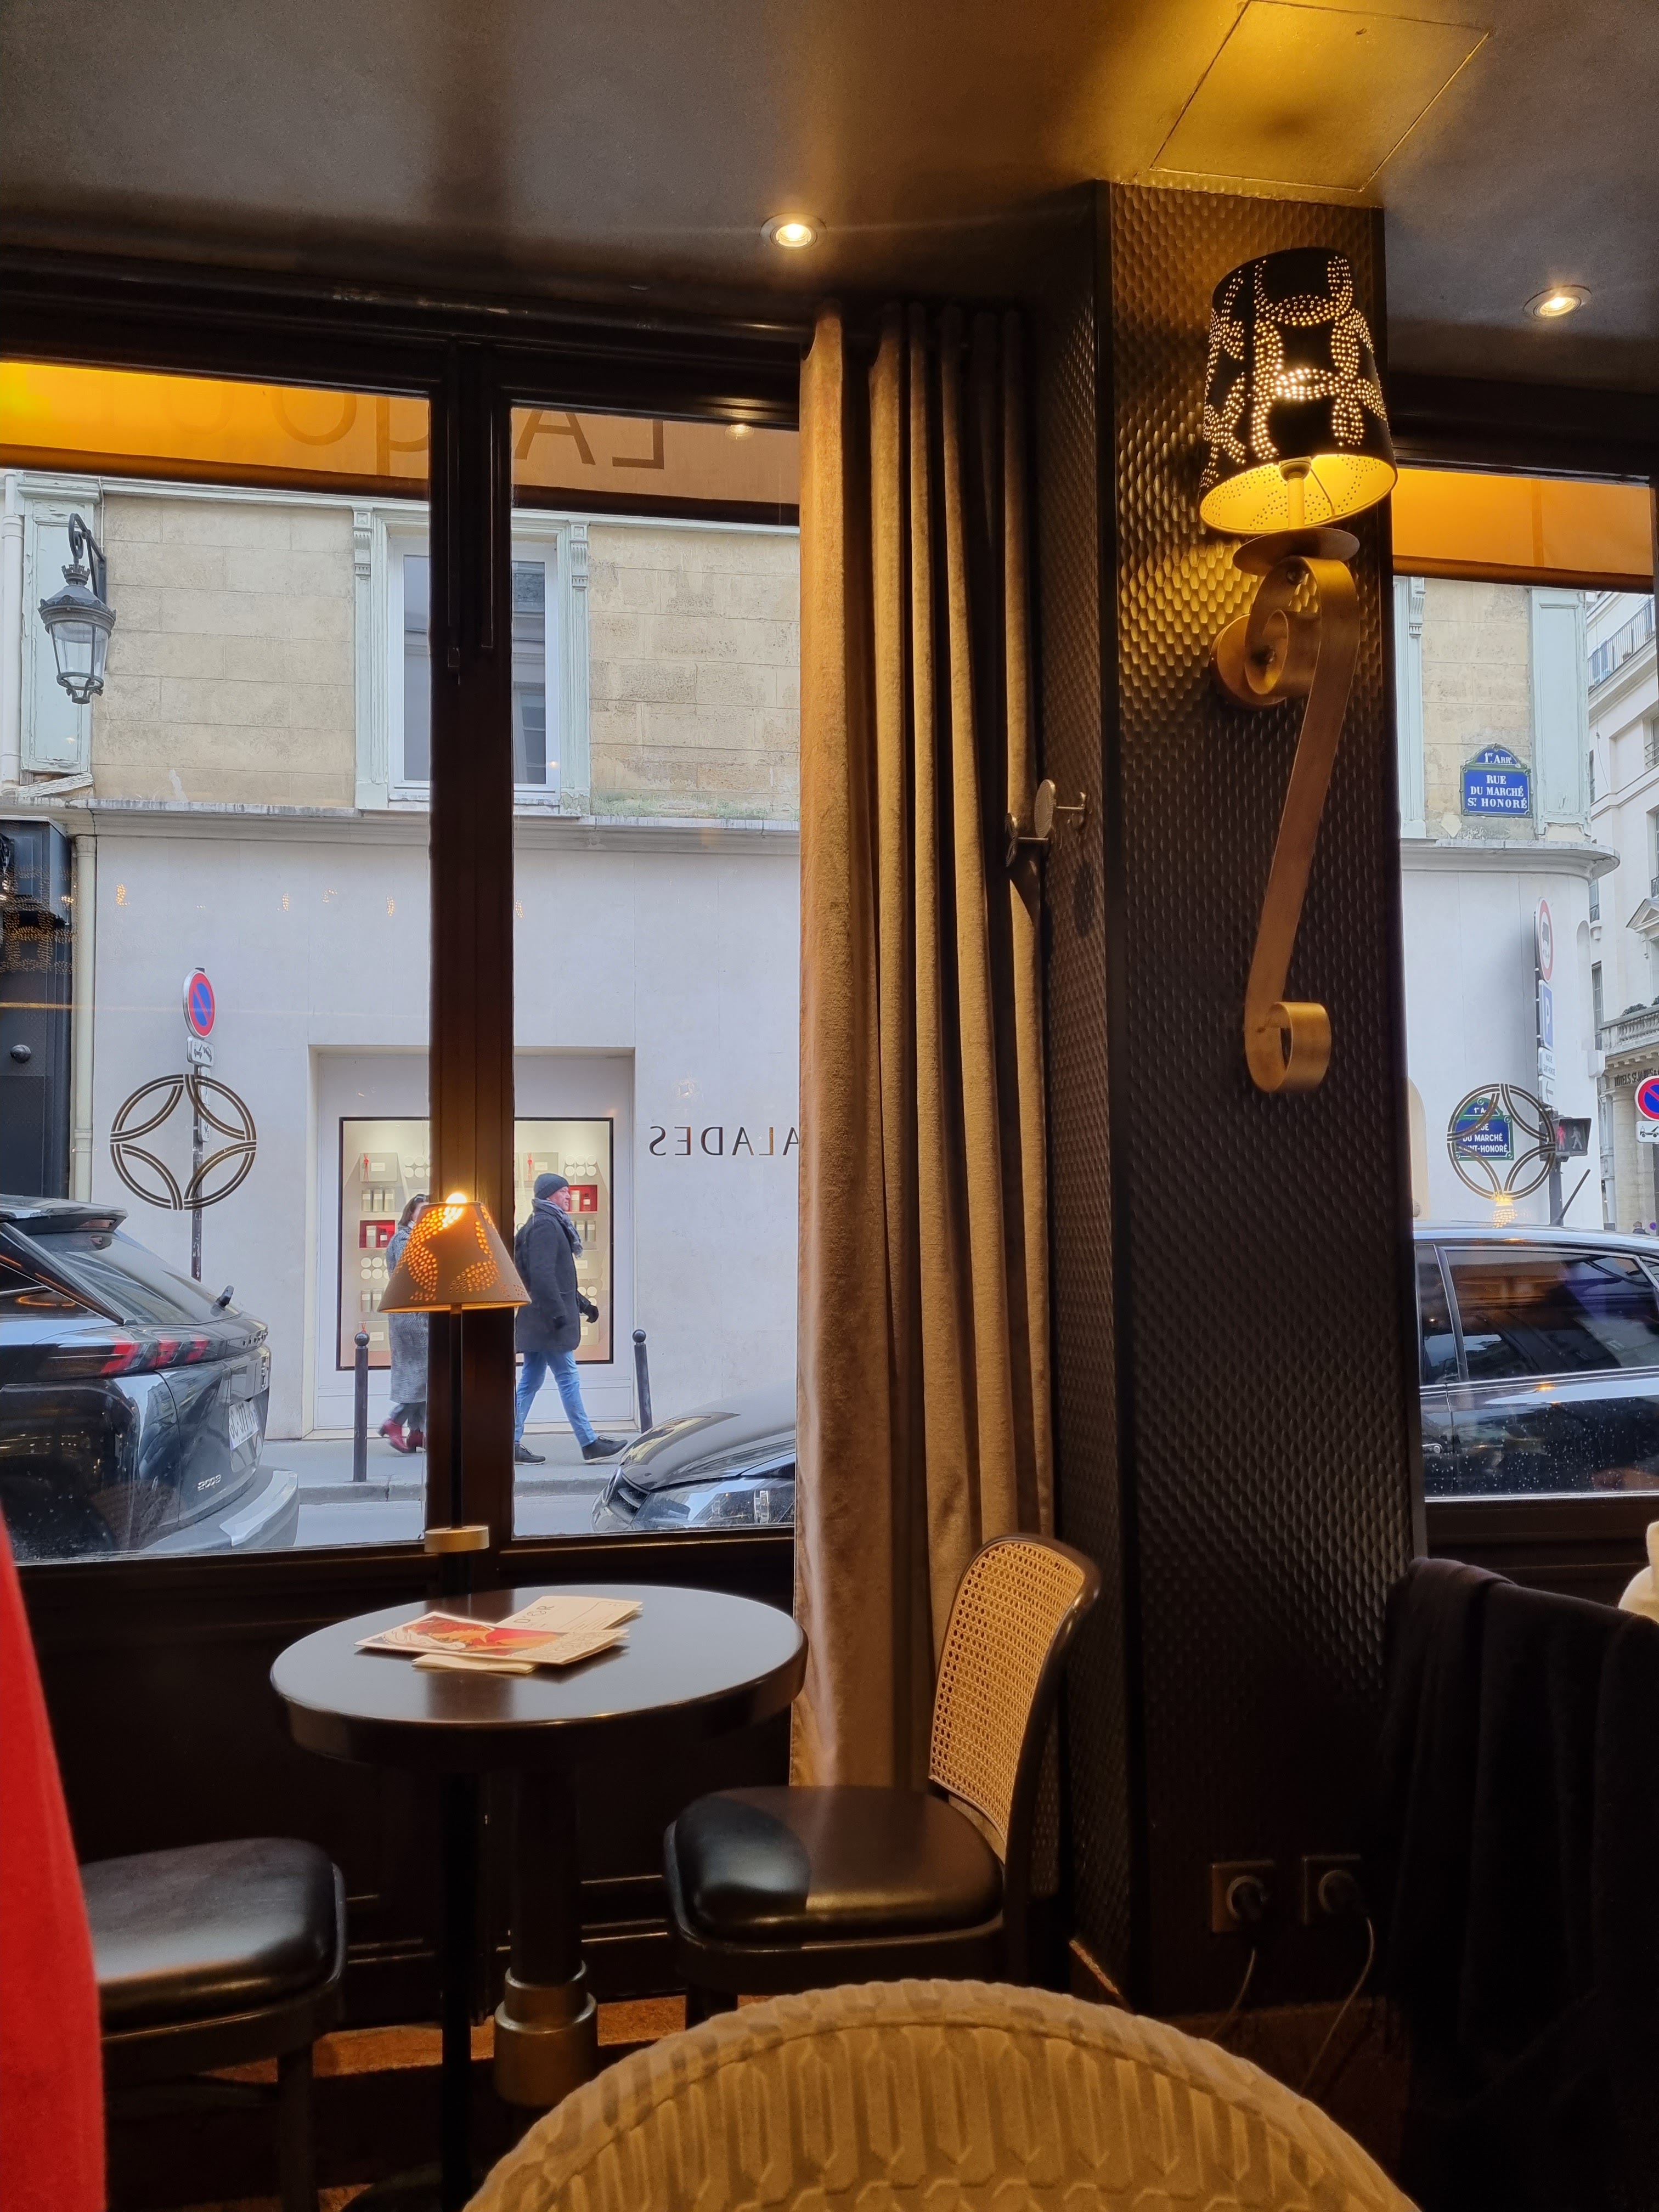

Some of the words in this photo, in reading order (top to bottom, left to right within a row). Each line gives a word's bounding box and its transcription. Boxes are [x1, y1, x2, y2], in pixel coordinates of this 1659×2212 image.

[1486, 775, 1506, 785] RUE
[1470, 786, 1483, 795] DU
[1487, 786, 1524, 797] MARCHÉ
[1481, 798, 1527, 809] HONORÉ
[1475, 1133, 1503, 1142] MARCHÉ
